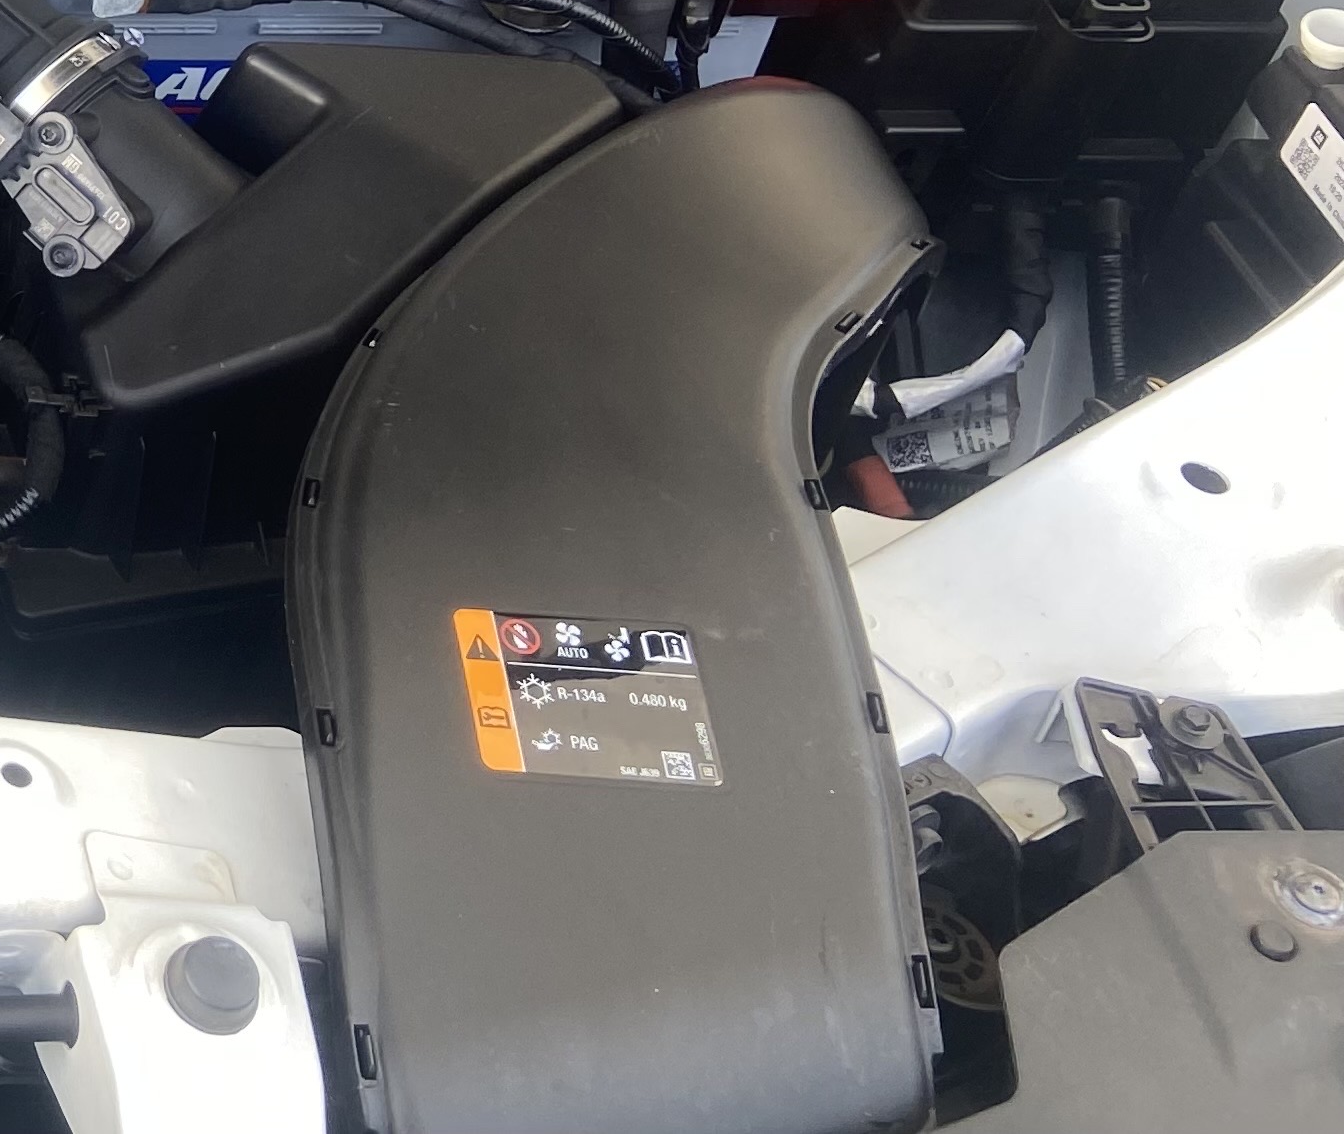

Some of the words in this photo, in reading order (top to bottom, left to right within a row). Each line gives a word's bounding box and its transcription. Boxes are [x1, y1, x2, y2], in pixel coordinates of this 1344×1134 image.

[557, 646, 589, 659] AUTO
[556, 686, 607, 704] R-134a
[628, 692, 666, 709] 0.480
[668, 695, 688, 711] kg
[570, 734, 600, 751] PAG
